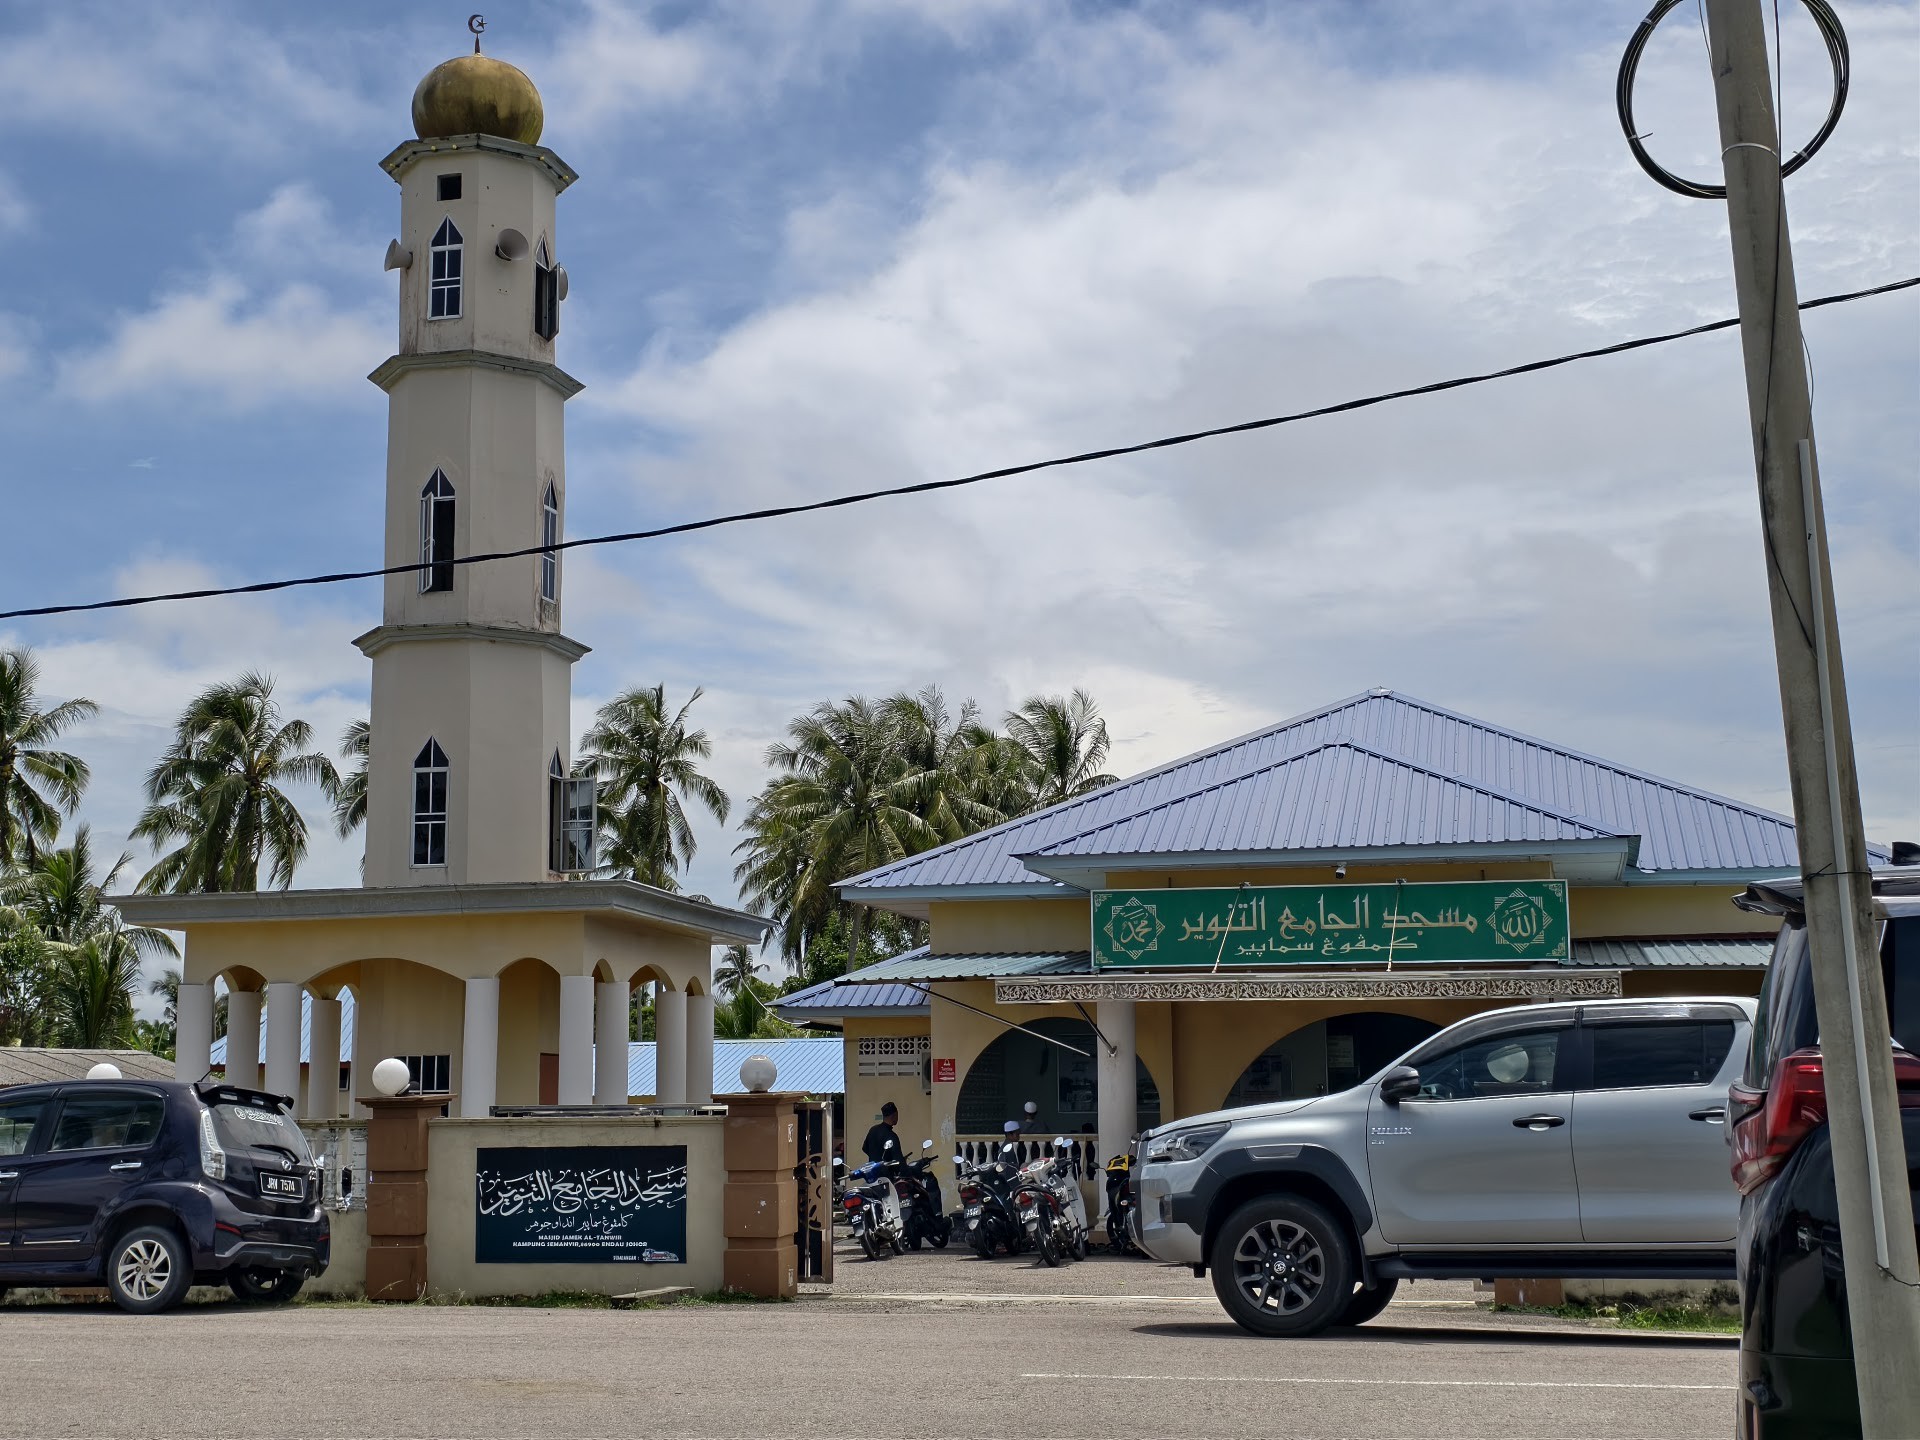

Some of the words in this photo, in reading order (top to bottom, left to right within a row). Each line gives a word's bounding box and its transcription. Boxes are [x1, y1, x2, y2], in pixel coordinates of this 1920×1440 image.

[1178, 895, 1266, 941] التنوير
[1277, 894, 1369, 940] الجامع
[1381, 905, 1478, 936] مسجد
[1371, 1127, 1412, 1135] HILUX
